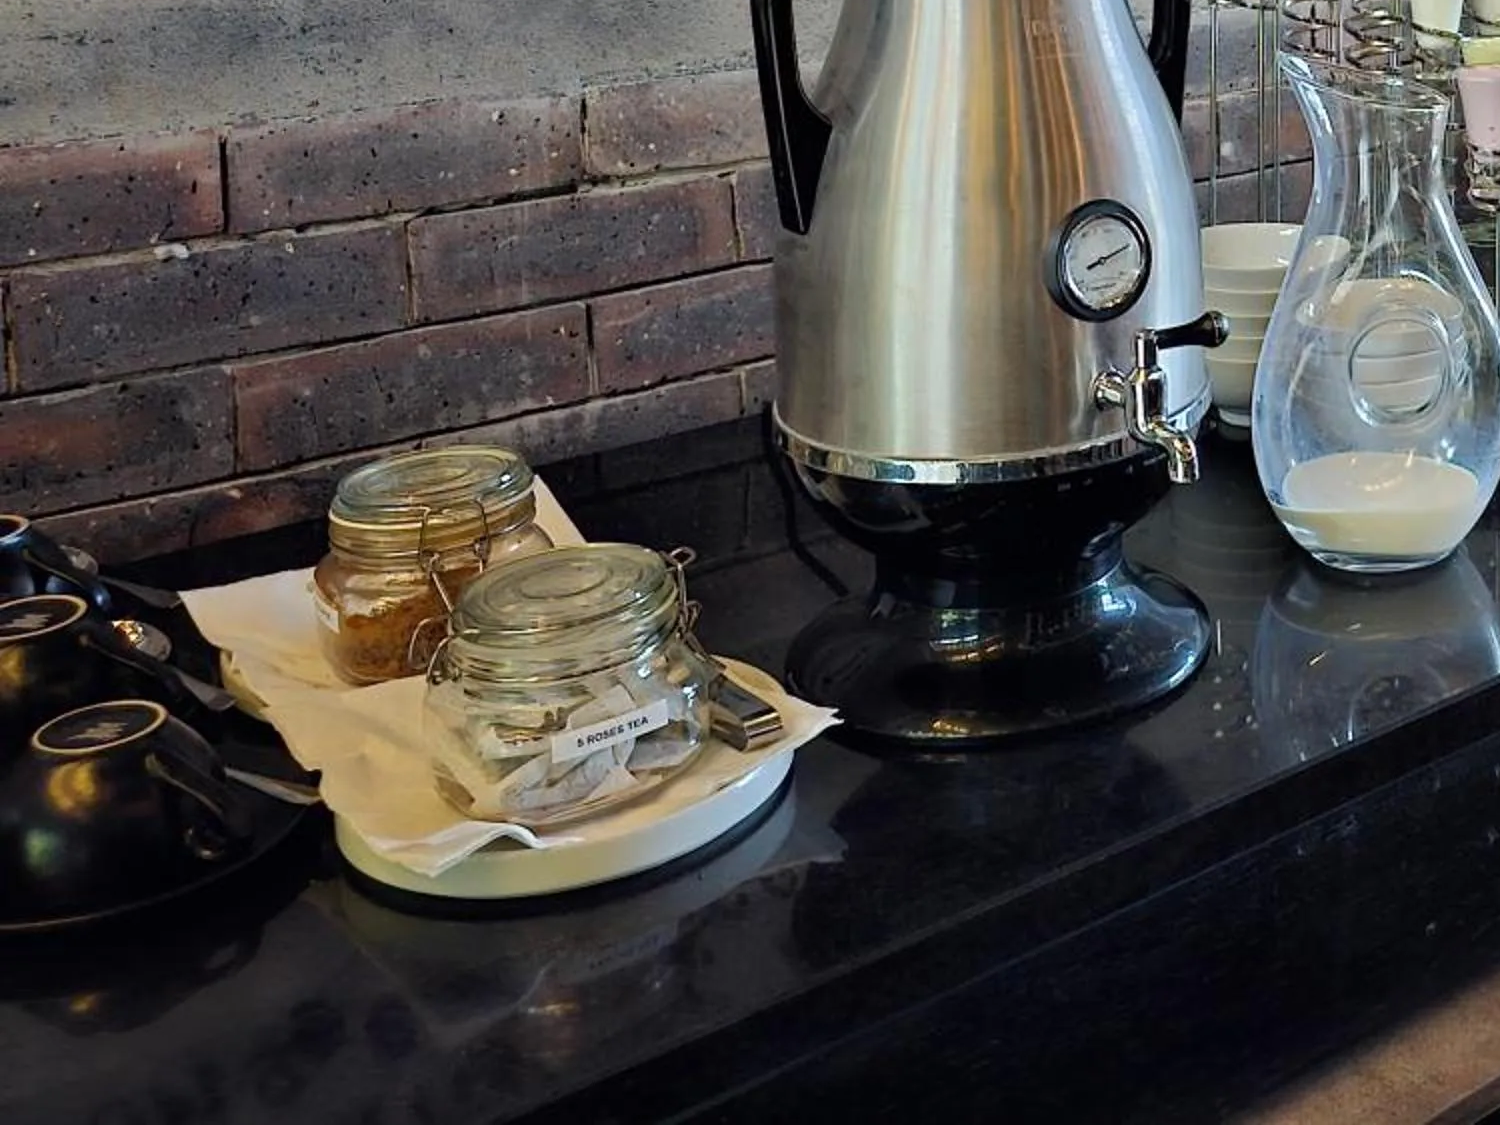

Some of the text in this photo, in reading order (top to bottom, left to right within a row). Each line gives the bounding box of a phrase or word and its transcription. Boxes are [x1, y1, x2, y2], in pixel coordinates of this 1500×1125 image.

[577, 716, 649, 748] 5 ROSES TEA
